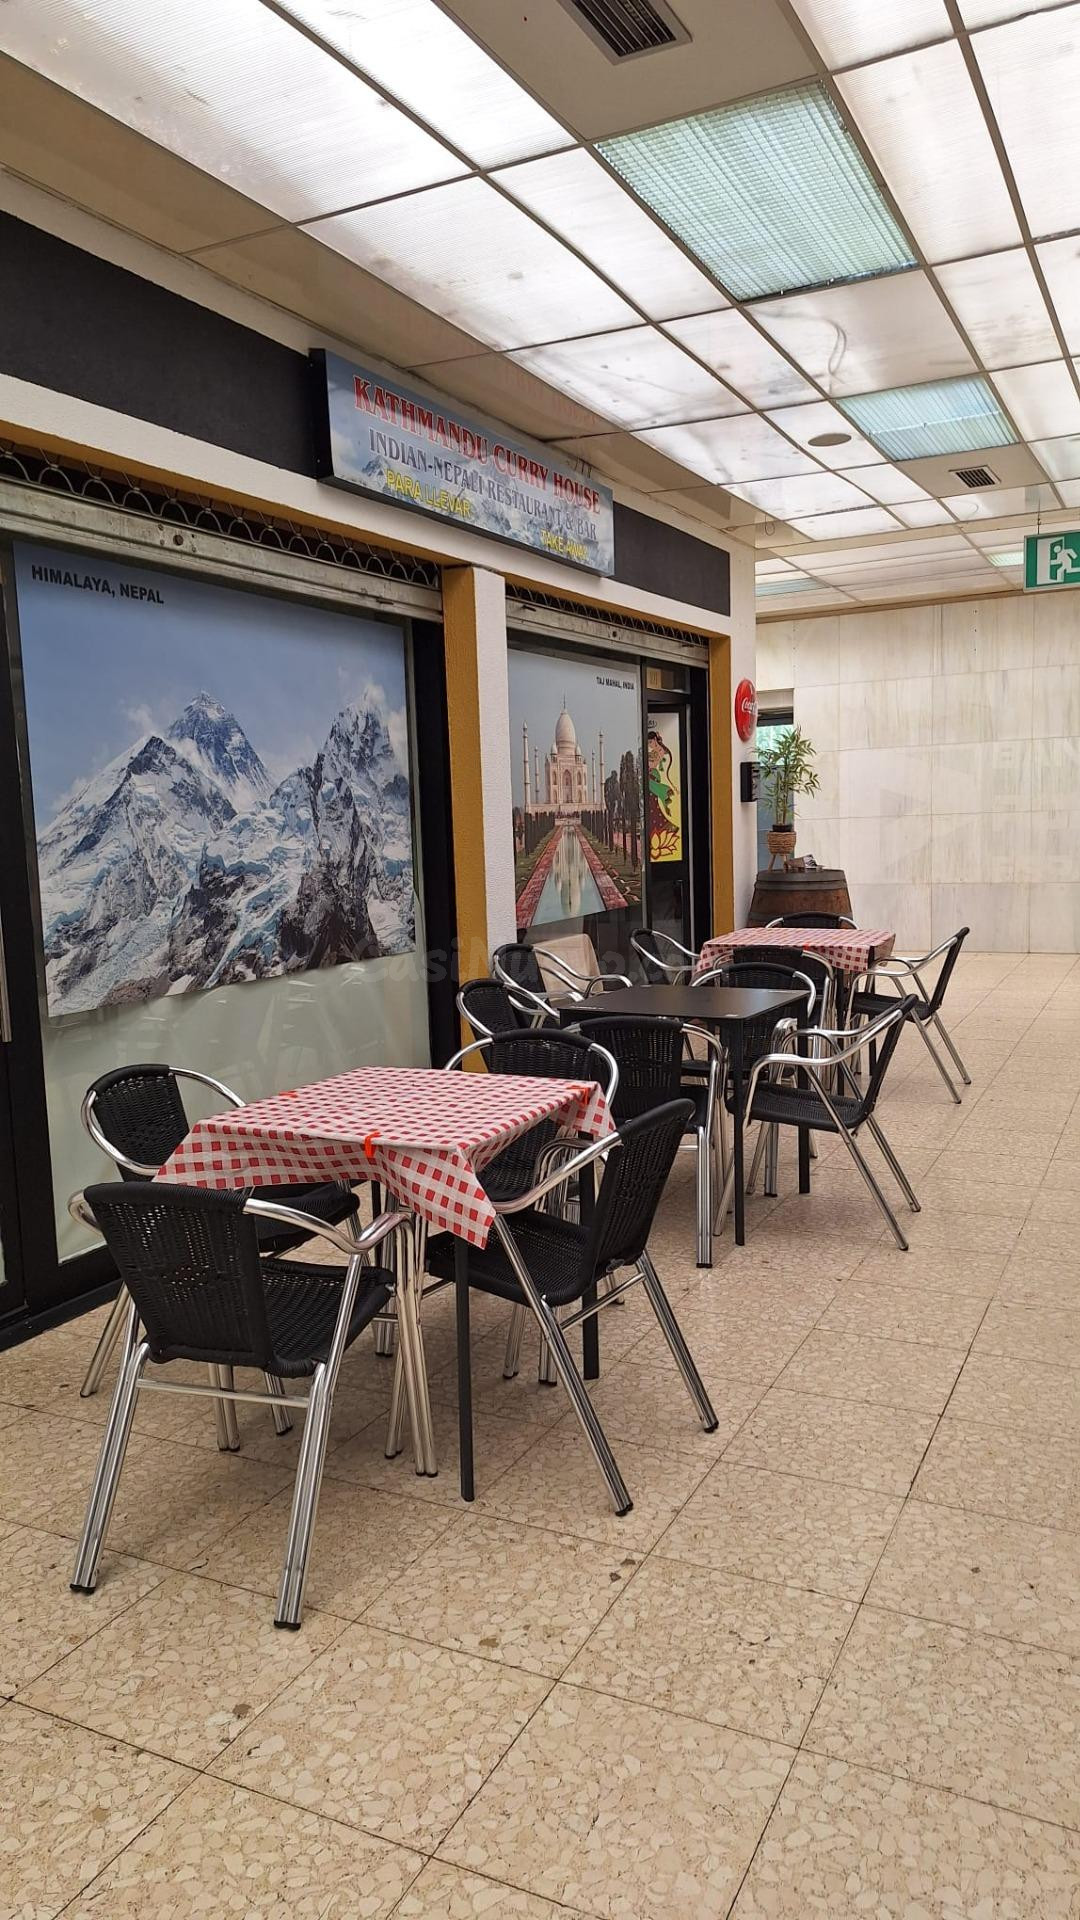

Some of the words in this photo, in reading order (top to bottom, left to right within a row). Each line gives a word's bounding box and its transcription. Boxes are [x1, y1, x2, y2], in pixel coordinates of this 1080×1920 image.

[353, 375, 488, 465] KATHMANDU
[493, 443, 549, 491] CURRY
[553, 472, 600, 515] HOUSE
[369, 429, 483, 496] INDIAN-NEPALI
[487, 479, 561, 527] RESTAURANT
[565, 512, 575, 532] &
[577, 519, 597, 541] BAR
[385, 468, 422, 500] PARA
[424, 482, 472, 518] LLEVAR
[541, 529, 564, 554] TAKE
[31, 564, 116, 598] HIMALAYA,
[119, 582, 165, 605] NEPAL
[596, 676, 605, 686] TAJ
[622, 681, 635, 690] INDIA
